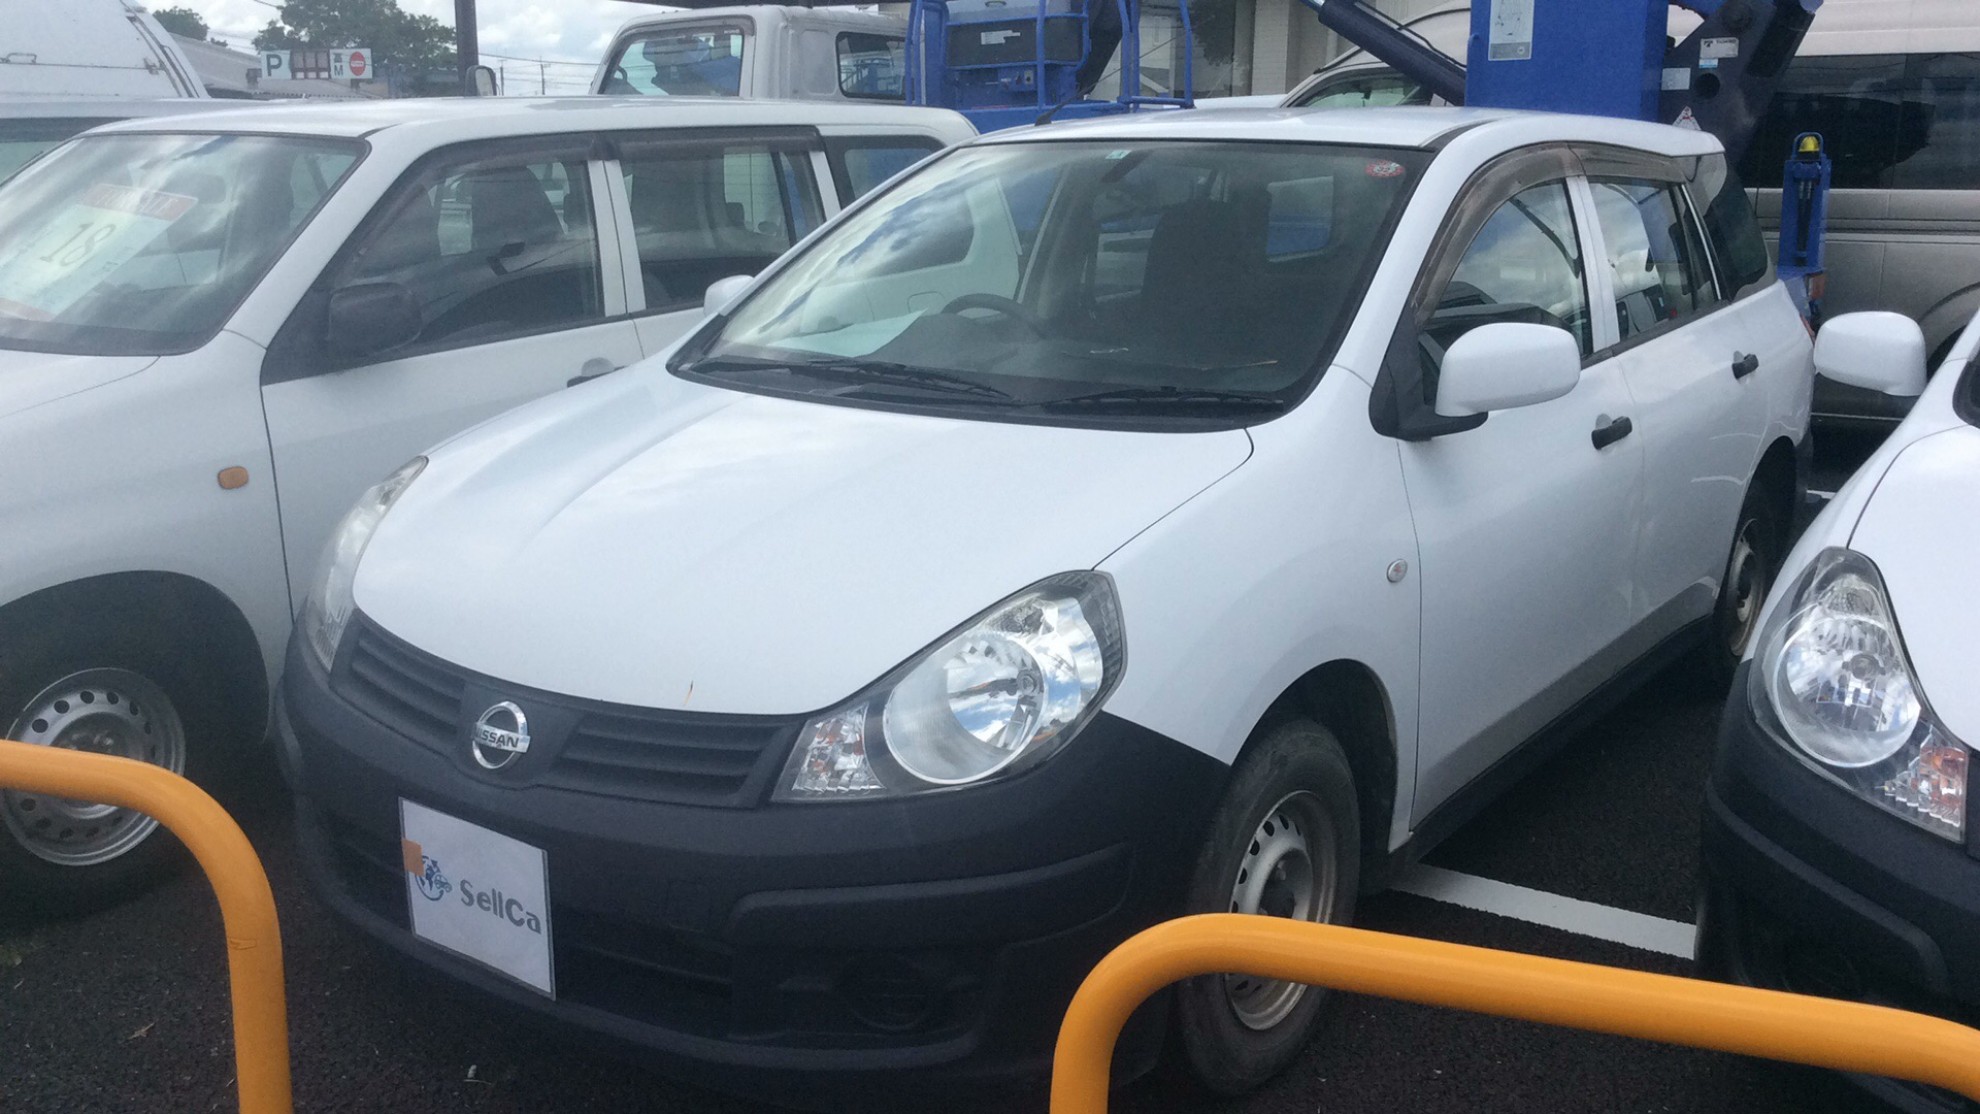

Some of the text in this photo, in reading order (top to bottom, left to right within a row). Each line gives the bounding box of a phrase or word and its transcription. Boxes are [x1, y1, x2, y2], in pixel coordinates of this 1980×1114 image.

[265, 53, 283, 77] P
[39, 222, 117, 267] 18
[459, 878, 542, 935] SellCa
